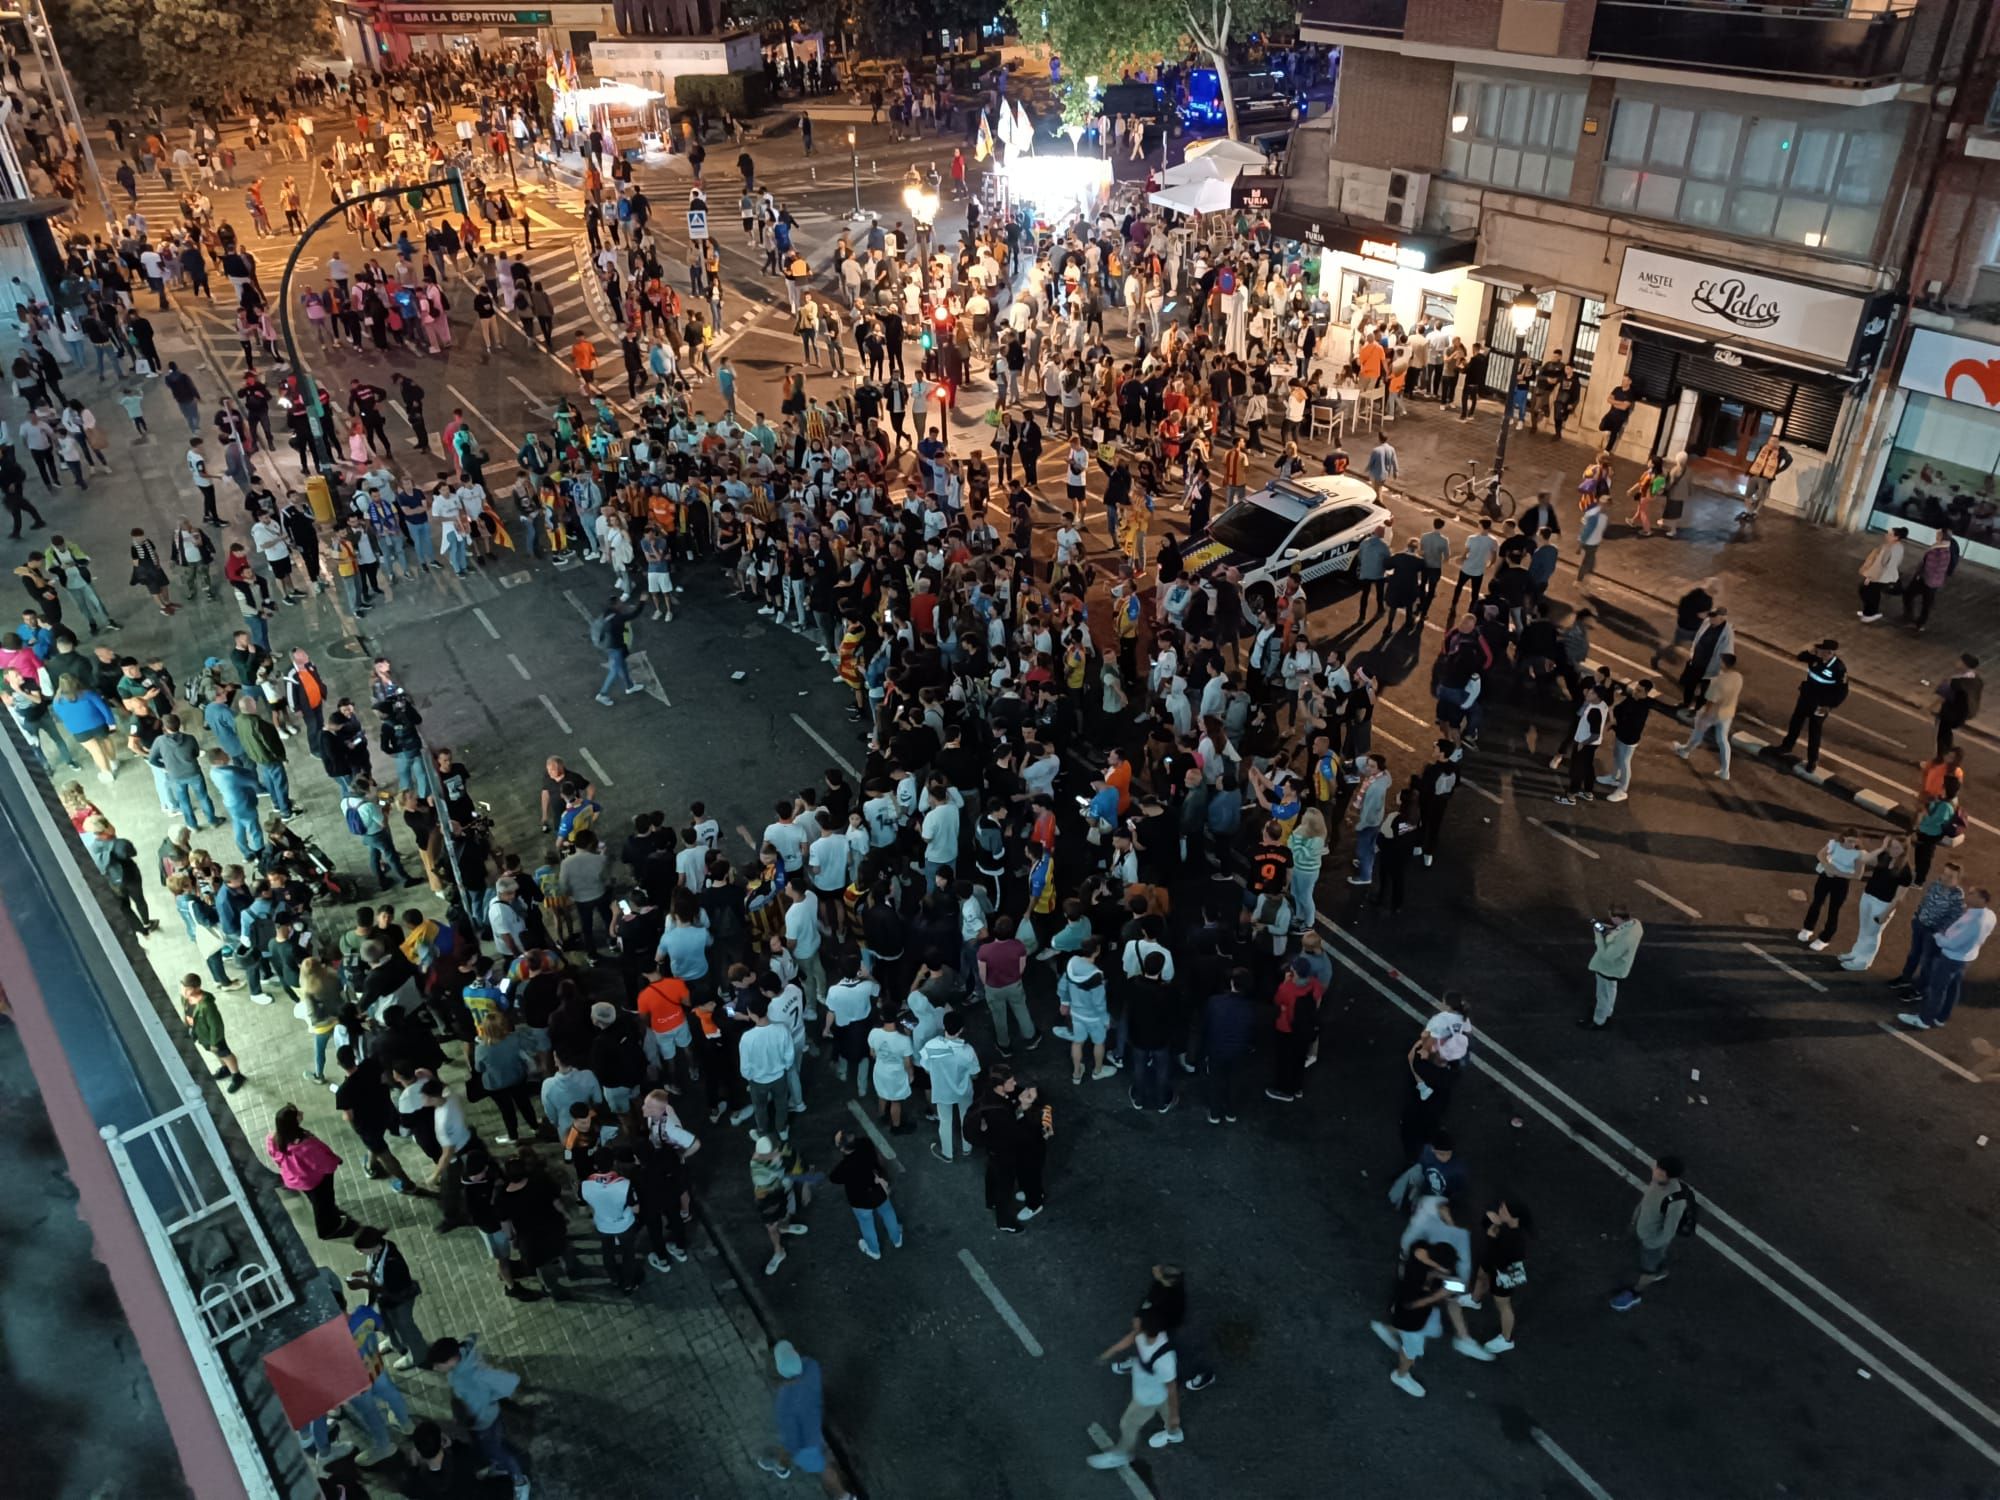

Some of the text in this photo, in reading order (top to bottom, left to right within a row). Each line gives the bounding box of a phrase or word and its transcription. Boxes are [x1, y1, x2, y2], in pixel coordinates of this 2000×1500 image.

[404, 13, 429, 22] BAR
[432, 13, 447, 22] LA
[451, 12, 517, 22] DEPORTIVA
[1243, 197, 1268, 205] TURIA
[1305, 231, 1325, 242] TURIA
[1638, 271, 1781, 318] AMSTEL El Palco
[1330, 543, 1350, 558] PLV
[1261, 864, 1275, 880] 9
[789, 1005, 799, 1028] 7
